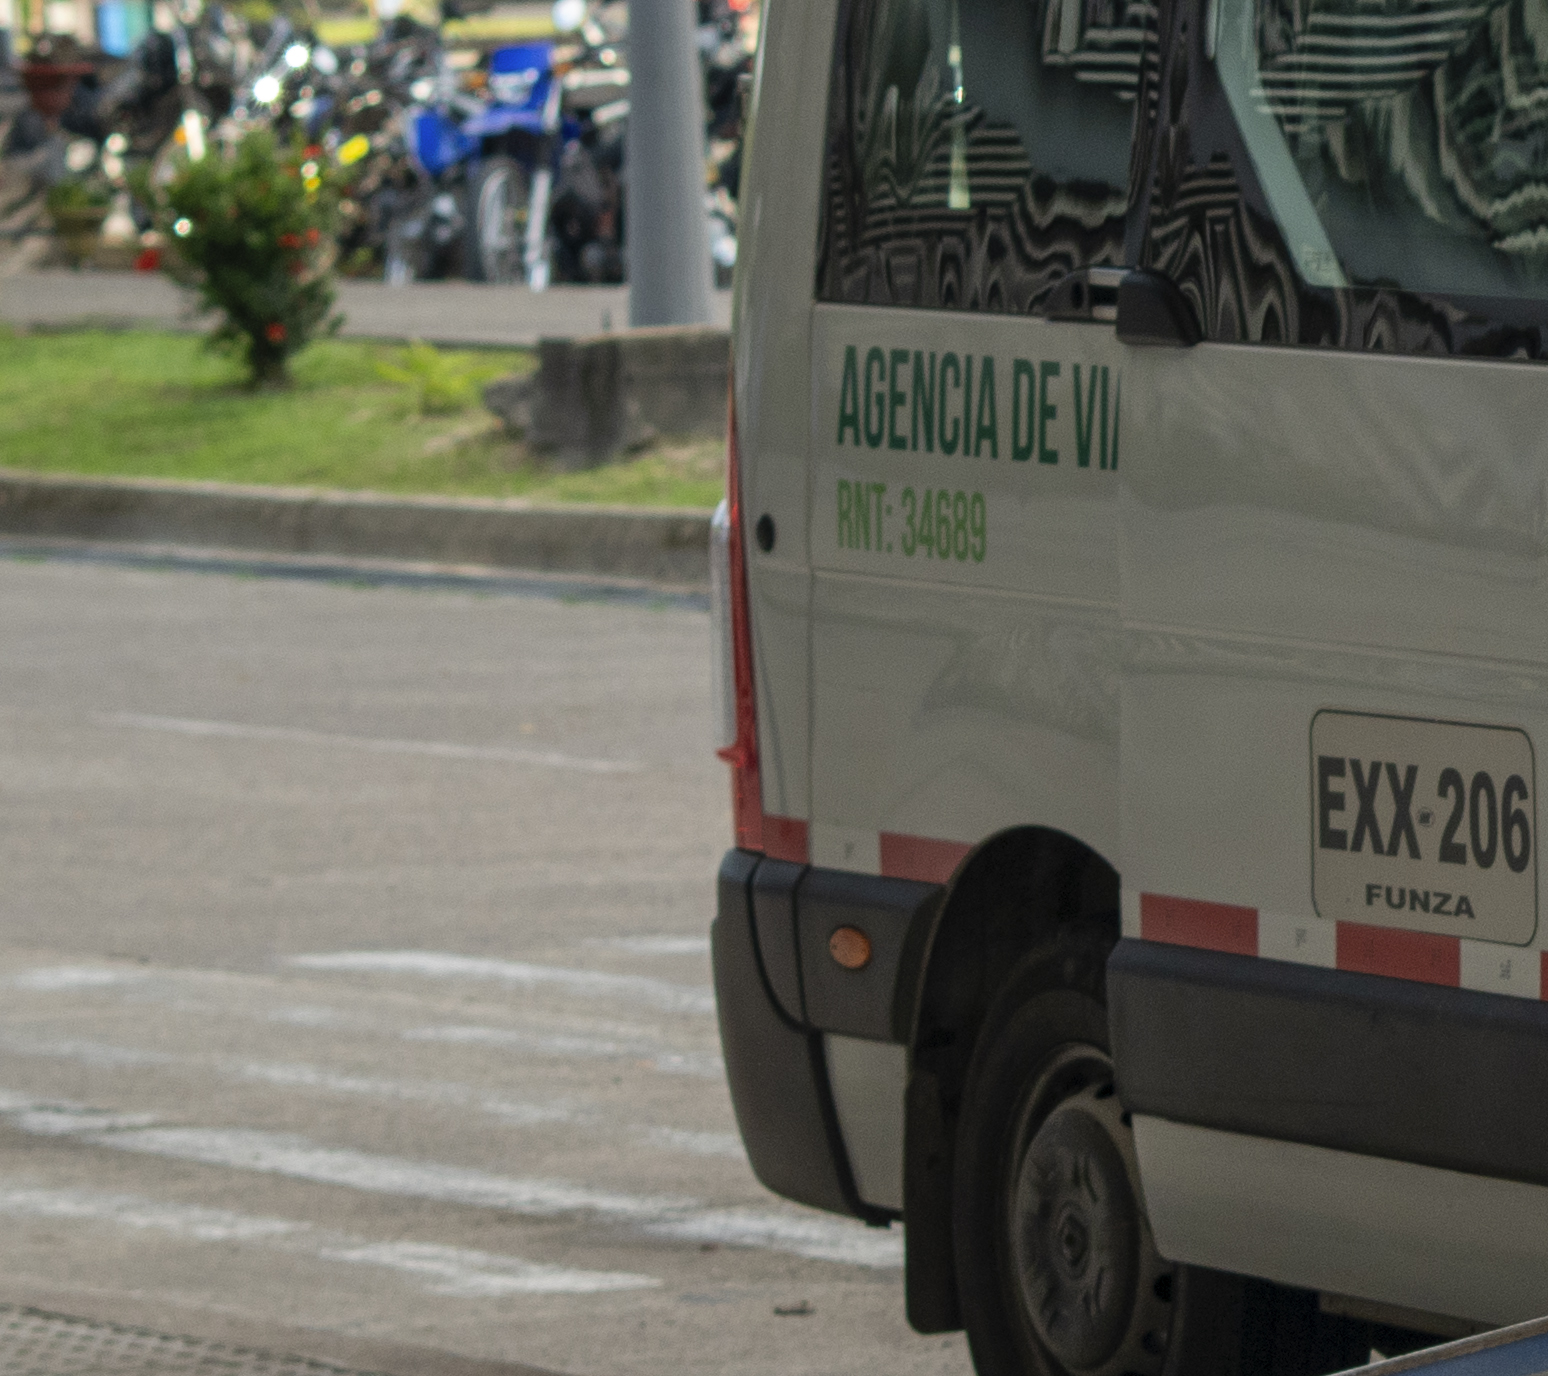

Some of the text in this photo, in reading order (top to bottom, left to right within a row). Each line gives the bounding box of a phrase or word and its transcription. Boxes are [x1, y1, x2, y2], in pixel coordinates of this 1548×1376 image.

[837, 344, 999, 460] AGENCIA
[1011, 358, 1061, 465] DE
[837, 479, 988, 563] RNT: 34689
[1365, 883, 1476, 919] FUNZA
